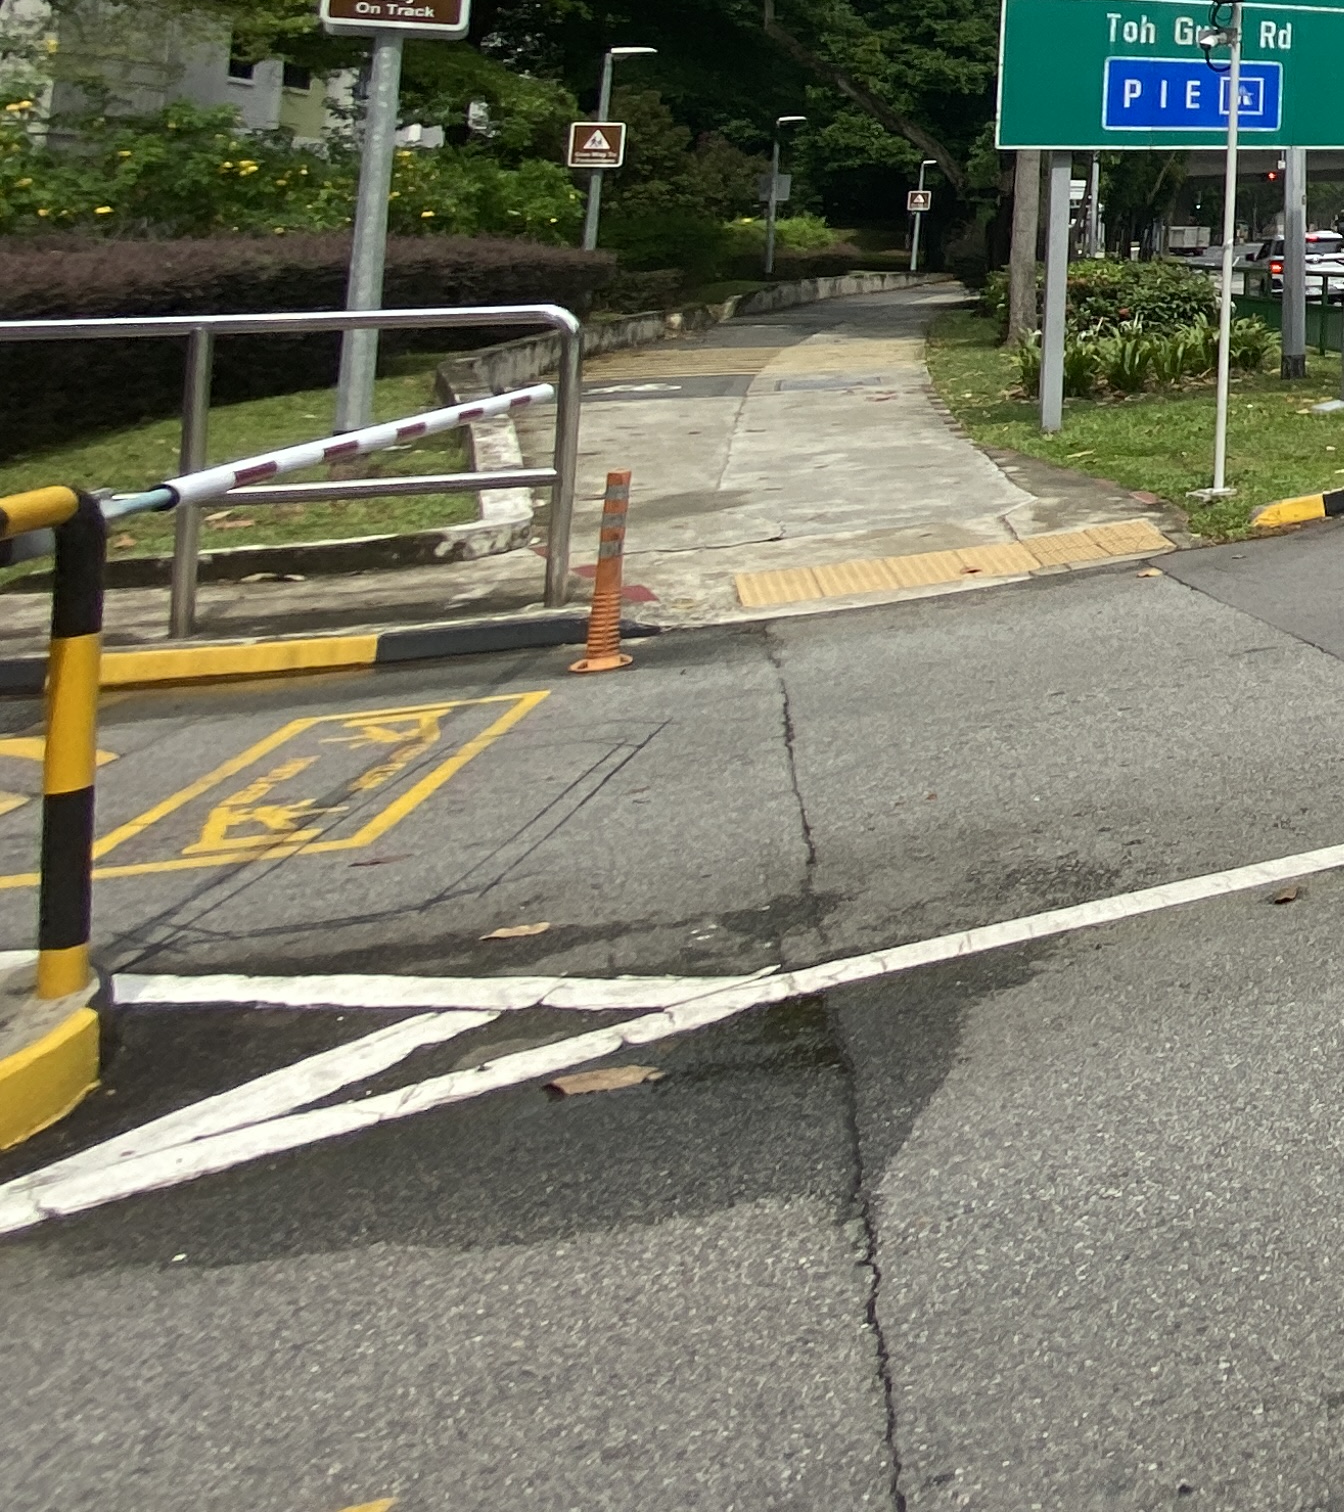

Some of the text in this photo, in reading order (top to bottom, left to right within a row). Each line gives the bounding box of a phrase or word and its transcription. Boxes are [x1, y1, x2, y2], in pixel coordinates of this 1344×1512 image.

[355, 1, 434, 17] On Track
[1106, 13, 1156, 44] Toh
[1260, 21, 1292, 49] Rd
